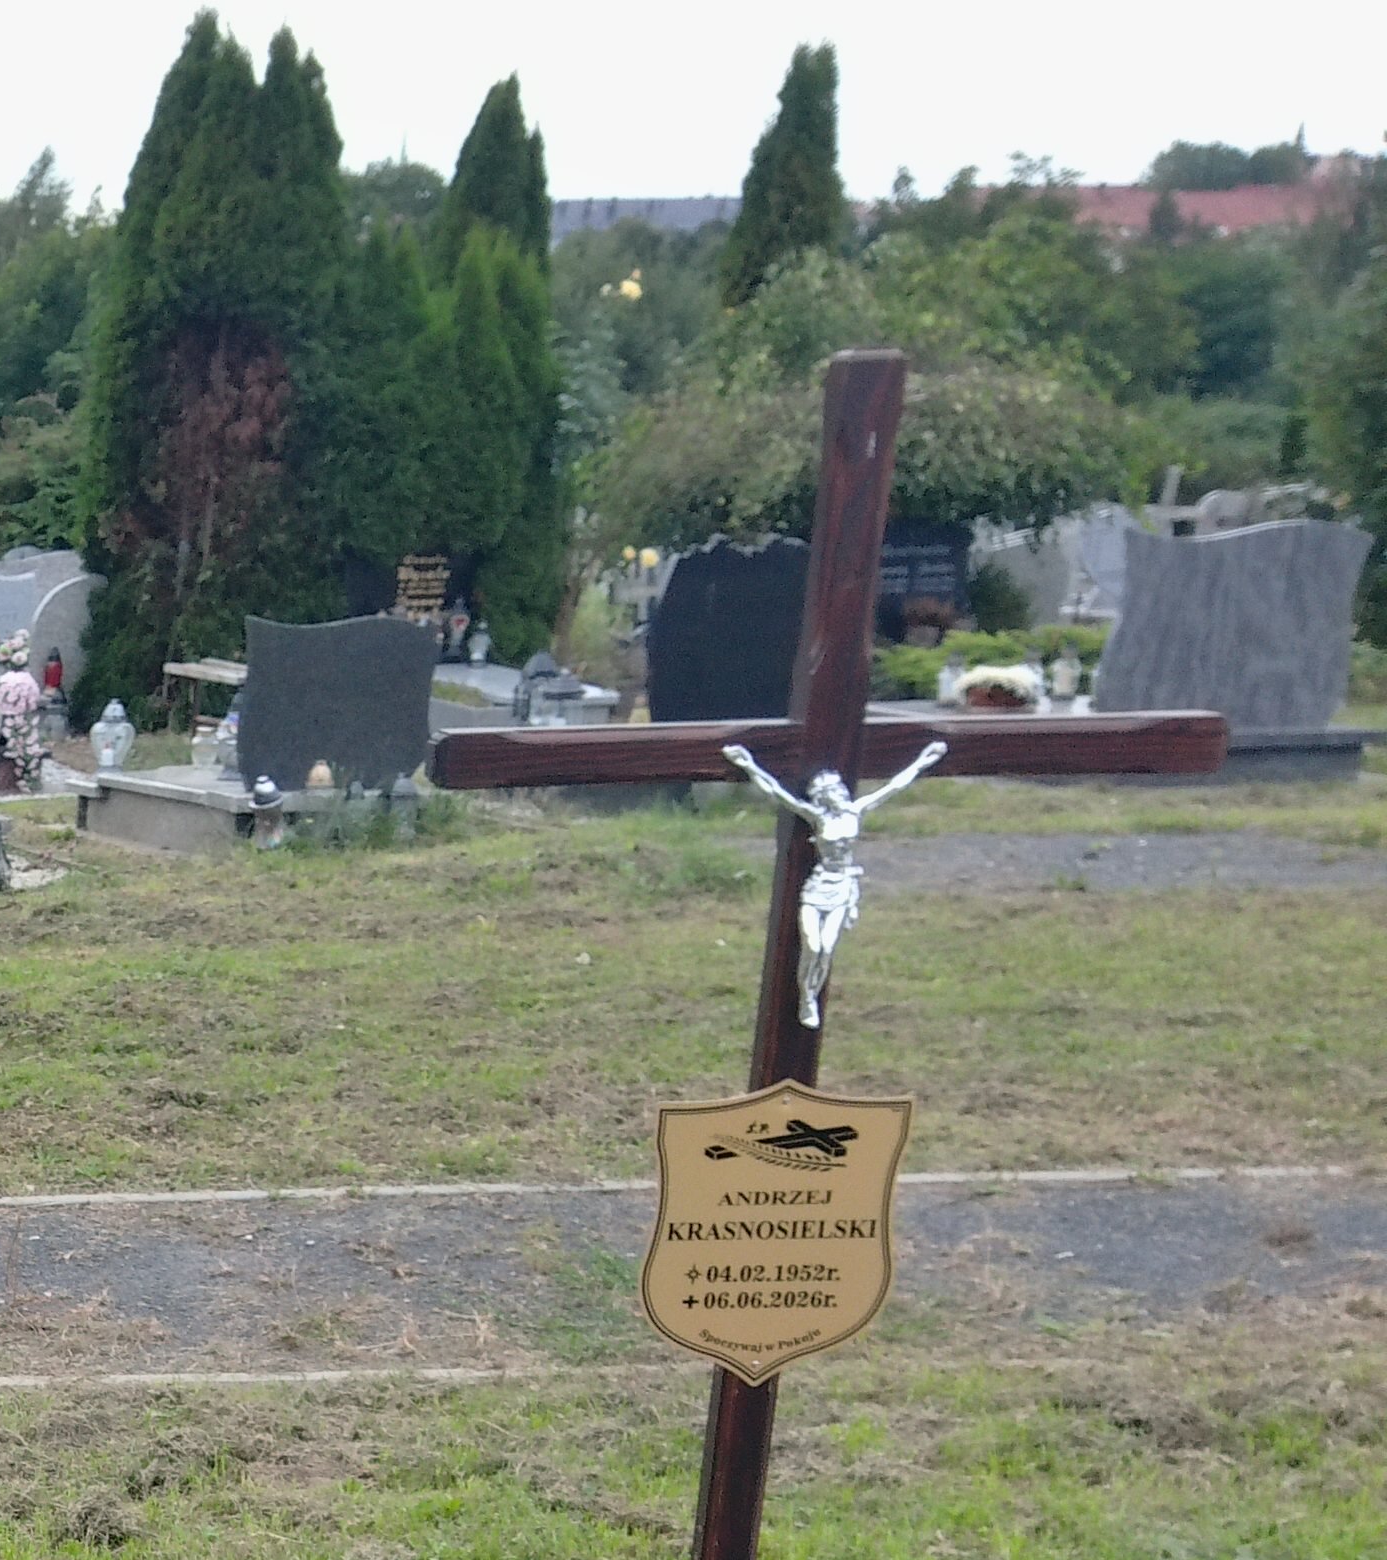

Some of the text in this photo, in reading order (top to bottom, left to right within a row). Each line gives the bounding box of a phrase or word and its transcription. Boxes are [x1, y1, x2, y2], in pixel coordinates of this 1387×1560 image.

[718, 1190, 833, 1207] ANDRZEJ
[667, 1218, 877, 1242] KRASNOSIELSKI
[705, 1265, 841, 1283] 04.02.1952r.
[704, 1291, 838, 1309] 06.06.2026r.
[699, 1328, 822, 1354] Spoczywaj w Pokoju
